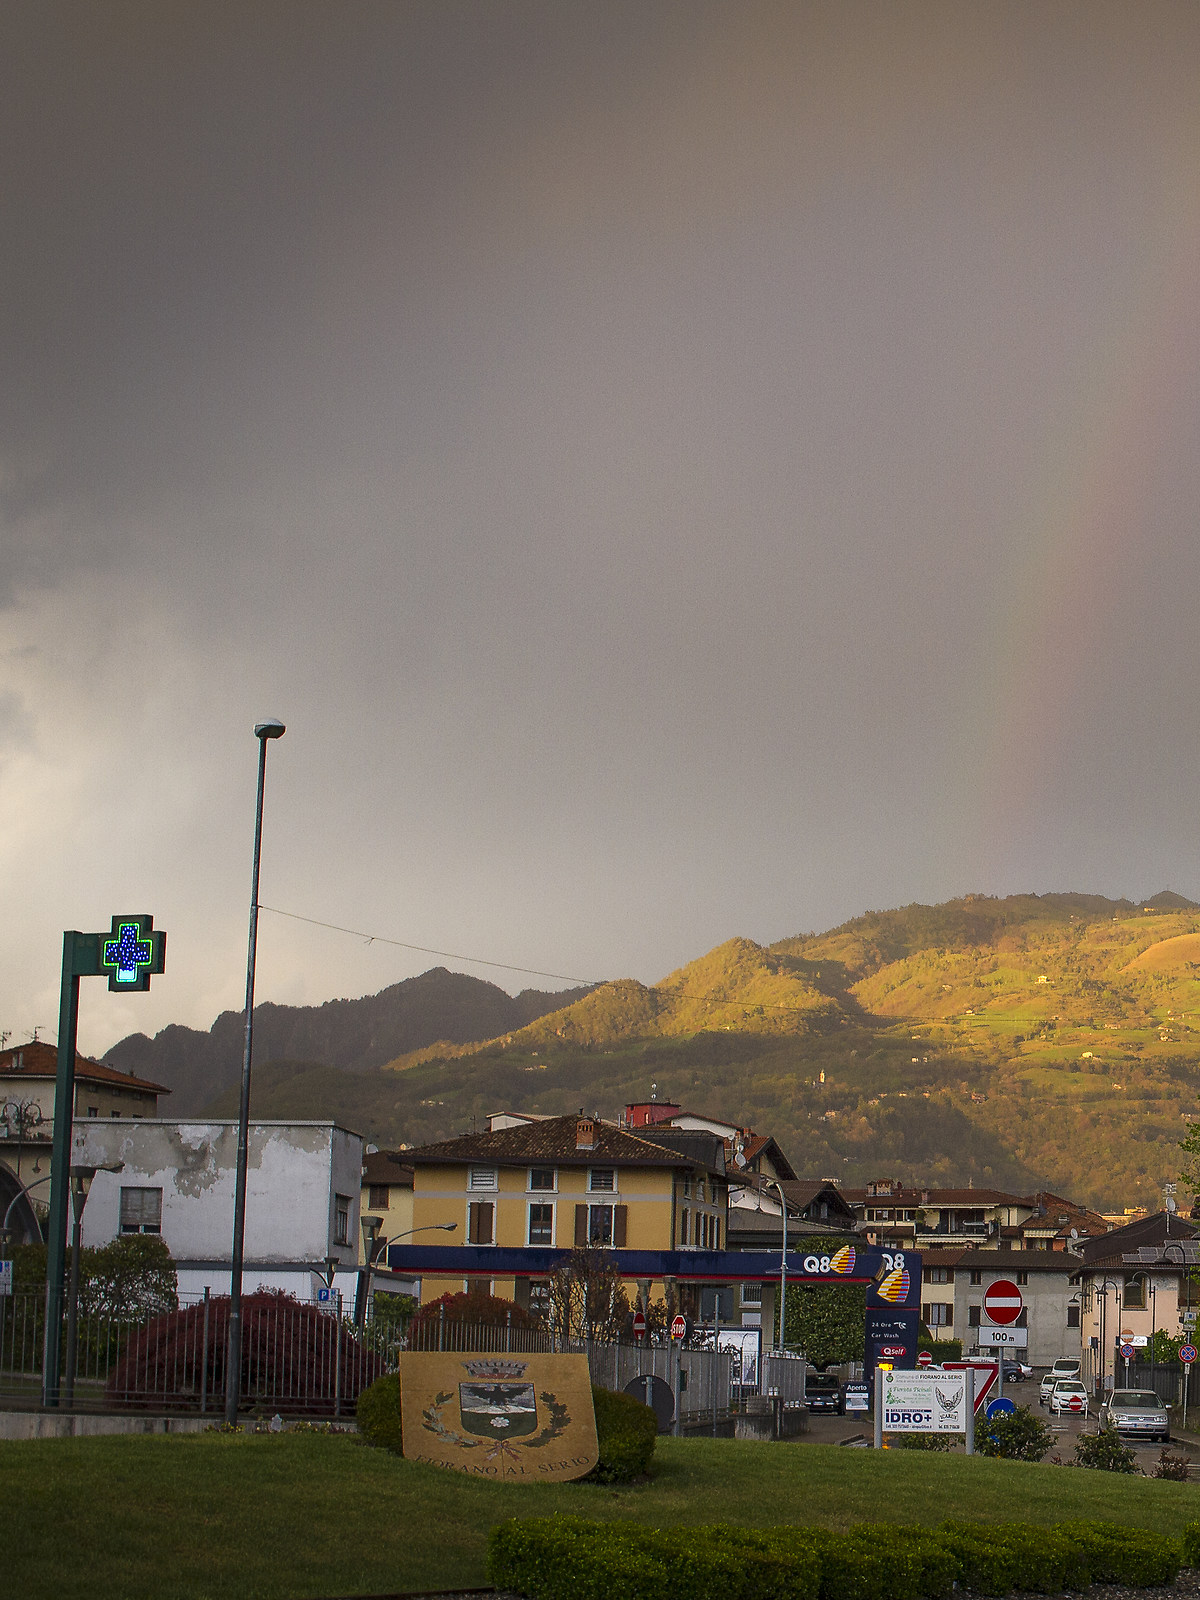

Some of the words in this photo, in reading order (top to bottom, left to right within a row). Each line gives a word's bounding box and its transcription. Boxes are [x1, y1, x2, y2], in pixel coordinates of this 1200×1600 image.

[803, 1256, 831, 1273] Q8
[672, 1323, 686, 1335] STOP
[992, 1332, 1008, 1341] 100
[413, 1454, 499, 1475] FIORANO
[506, 1466, 531, 1475] AL
[538, 1456, 591, 1474] SERIO
